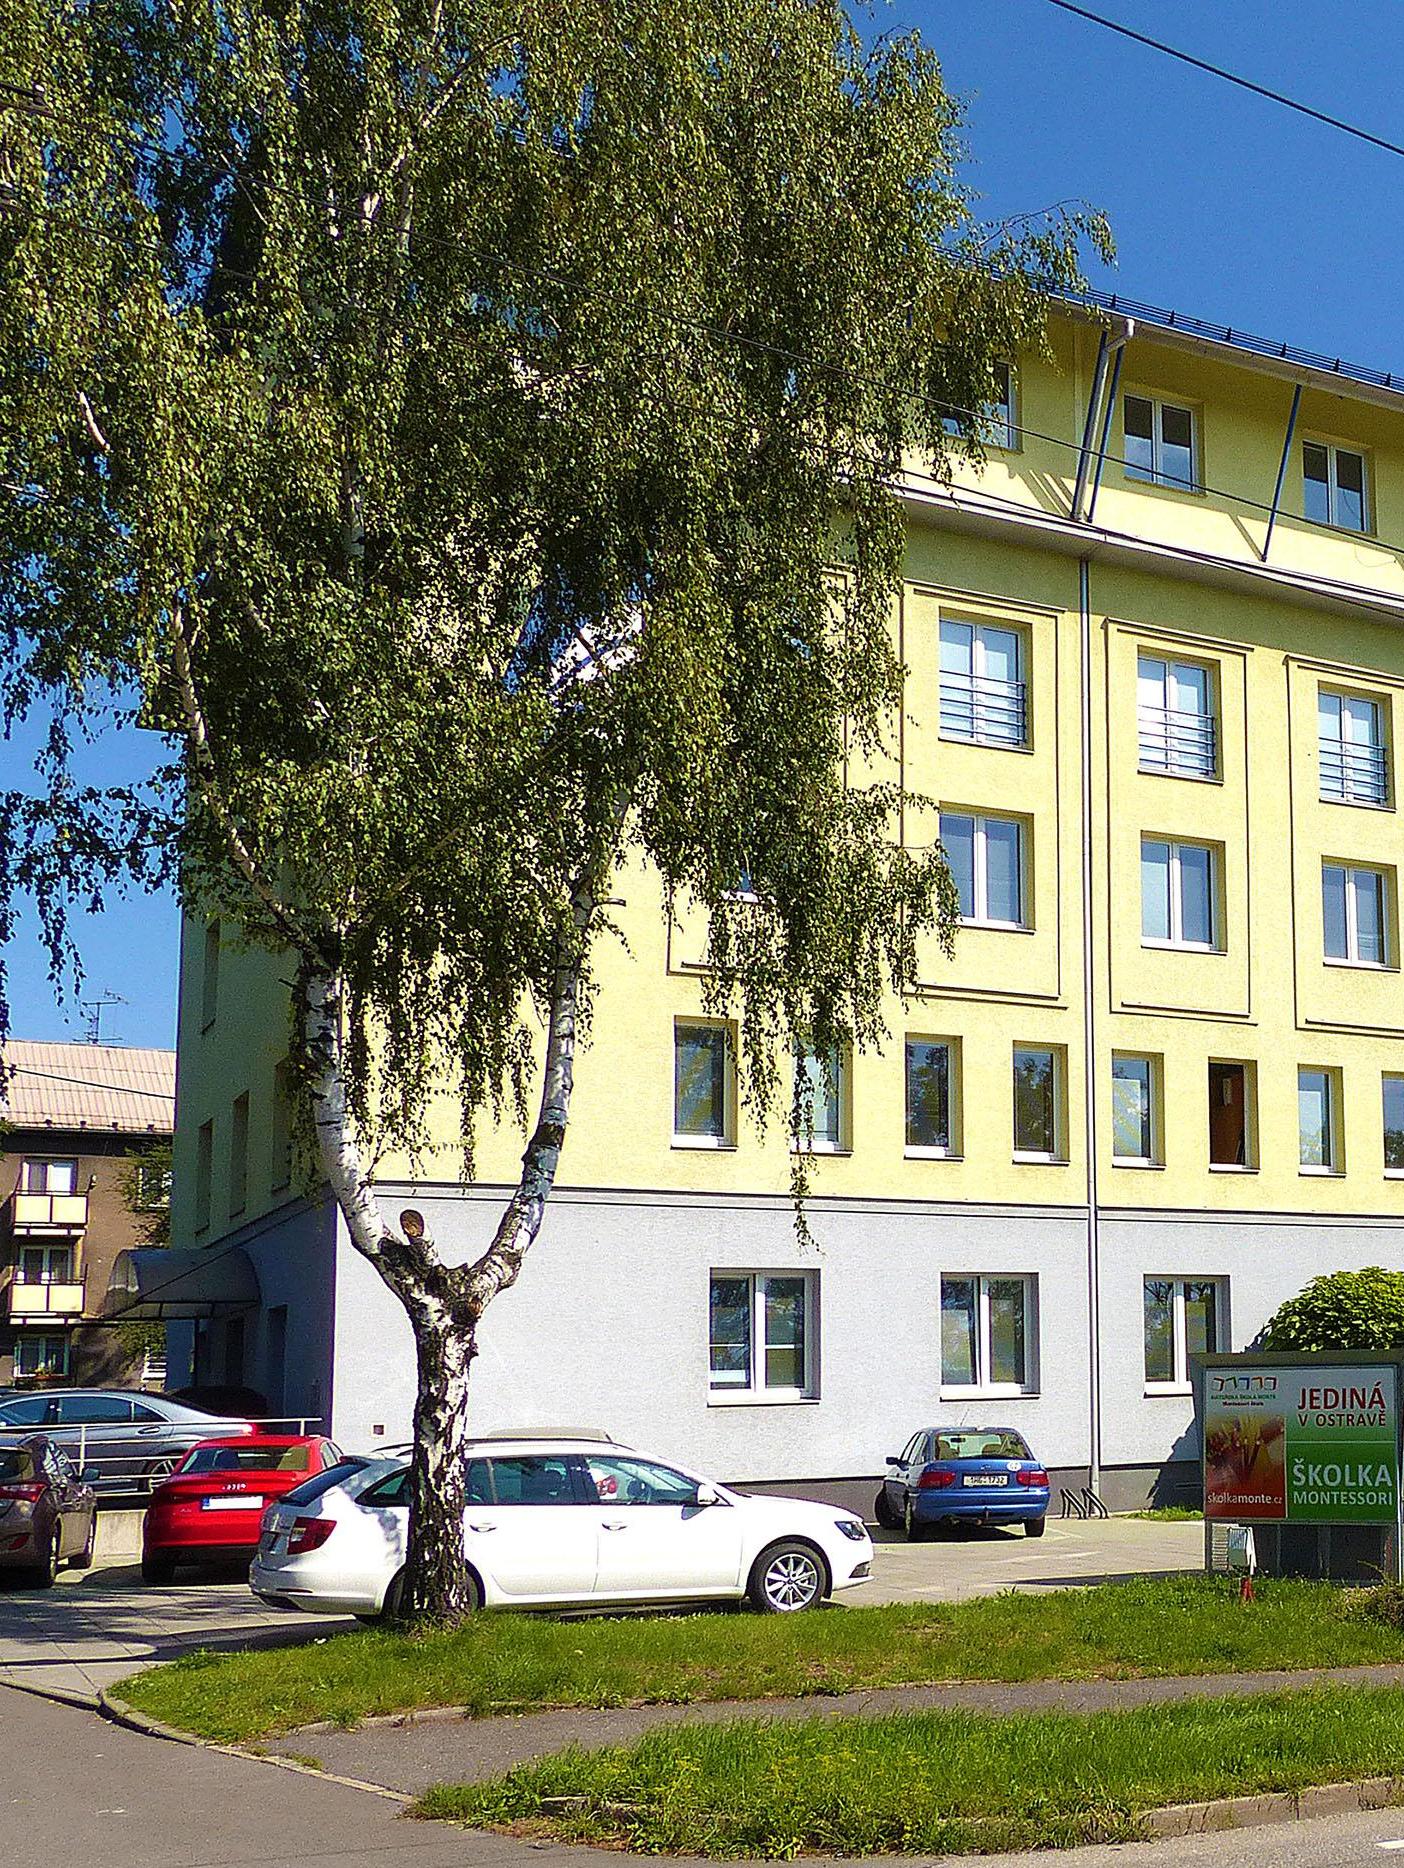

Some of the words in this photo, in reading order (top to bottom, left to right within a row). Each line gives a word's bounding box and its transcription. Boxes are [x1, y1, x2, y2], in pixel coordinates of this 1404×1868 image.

[1297, 1381, 1386, 1410] JEDINÁ
[1298, 1413, 1308, 1427] V
[1315, 1410, 1386, 1427] OSTRAVĚ
[1292, 1458, 1393, 1487] ŠKOLKA
[1293, 1491, 1393, 1506] MONTESSORI
